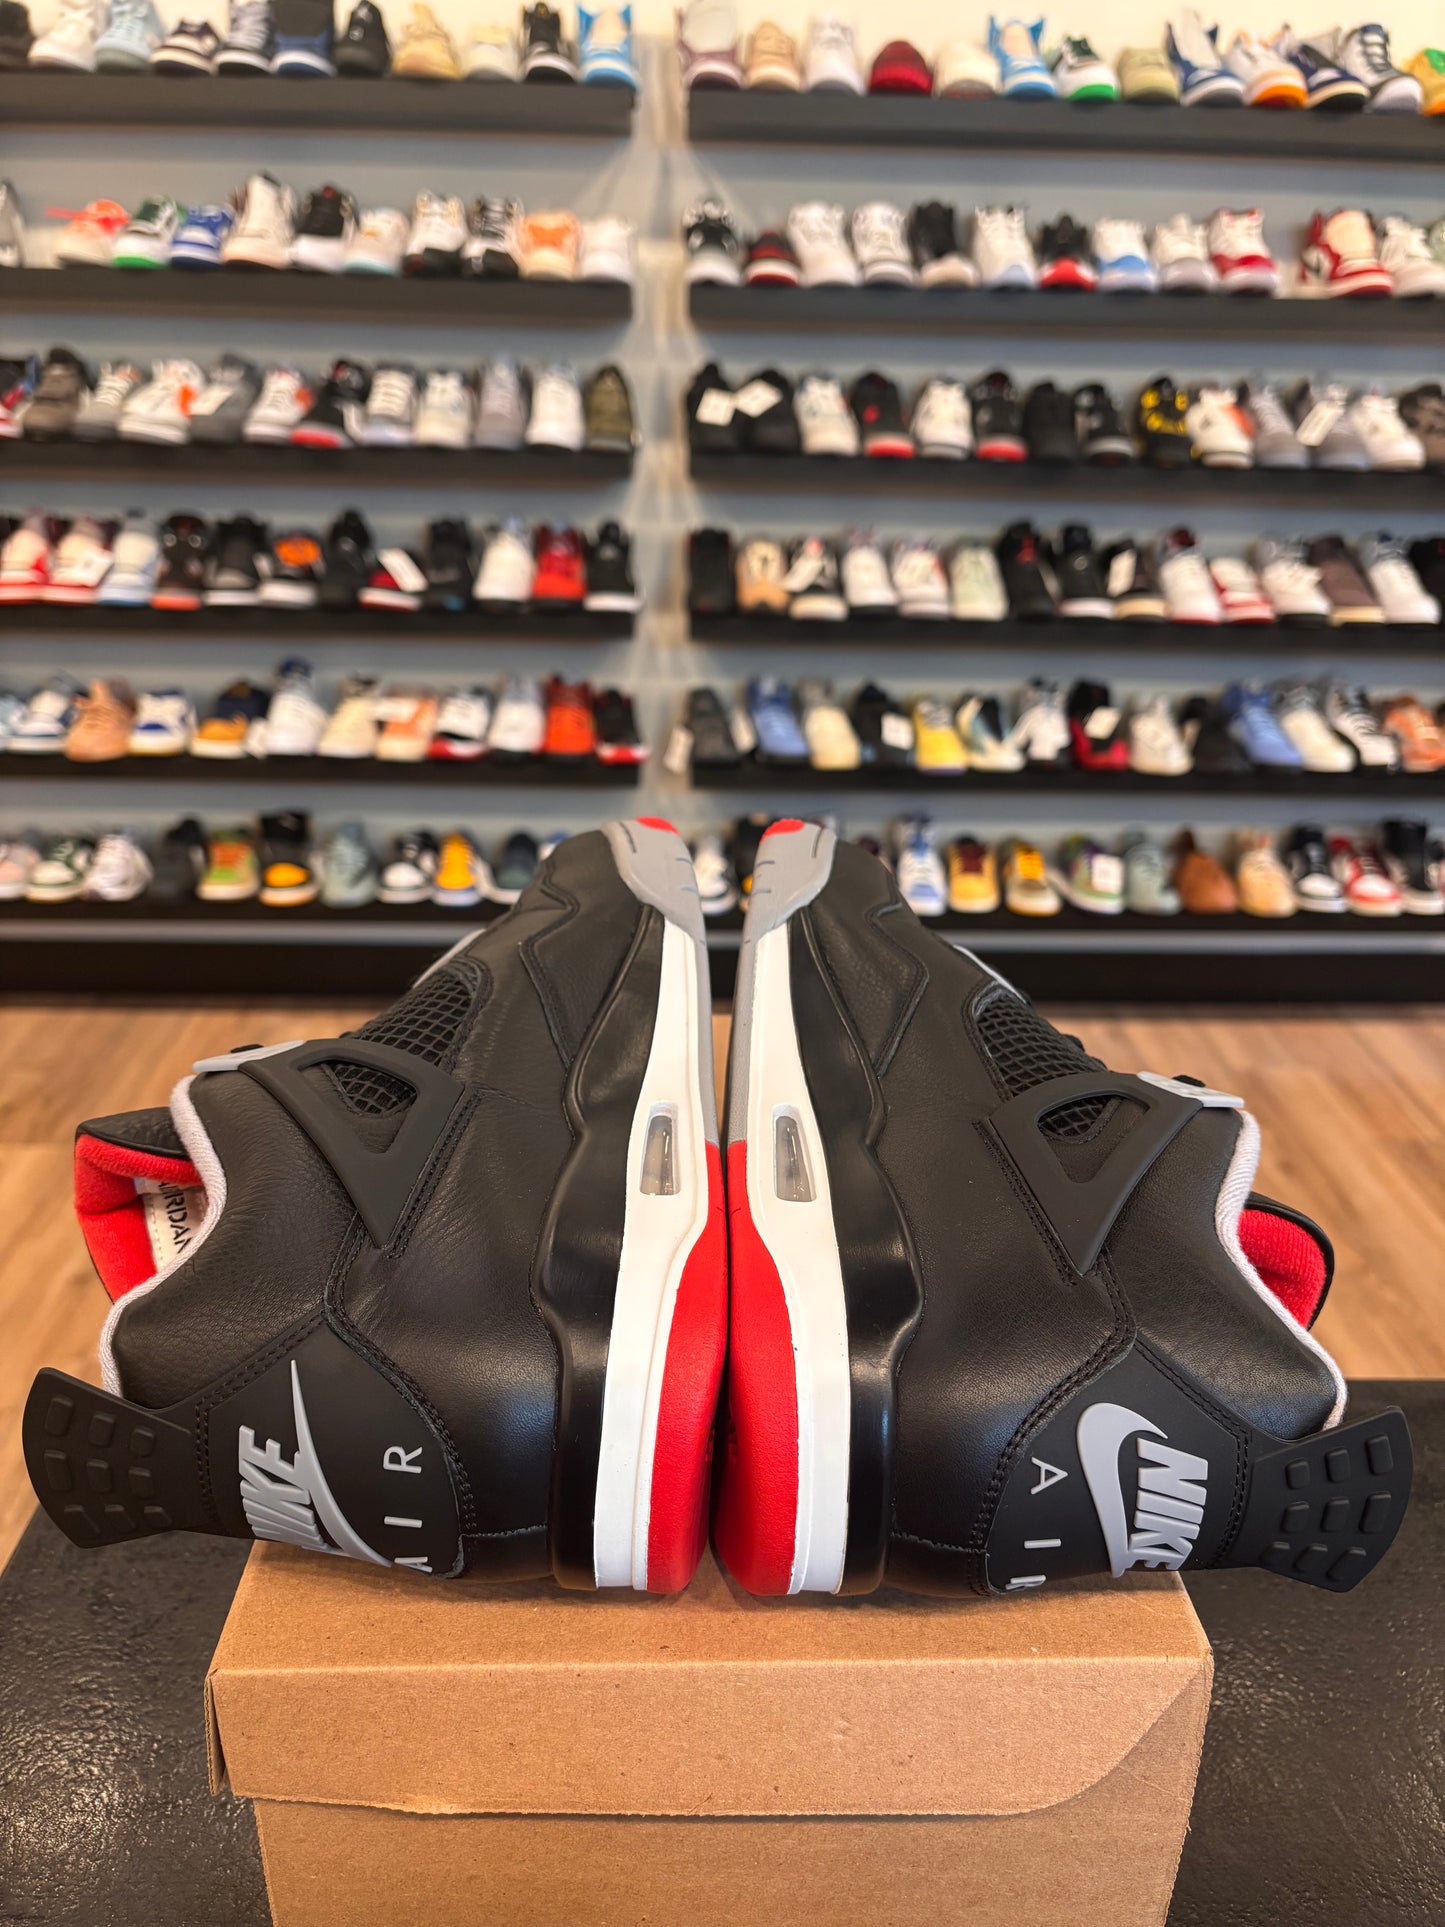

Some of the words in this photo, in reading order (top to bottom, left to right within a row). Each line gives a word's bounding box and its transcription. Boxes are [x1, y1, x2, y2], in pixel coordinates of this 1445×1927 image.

[239, 1425, 328, 1550] NIKE
[383, 1446, 433, 1573] AIR
[1128, 1437, 1209, 1570] NIKE
